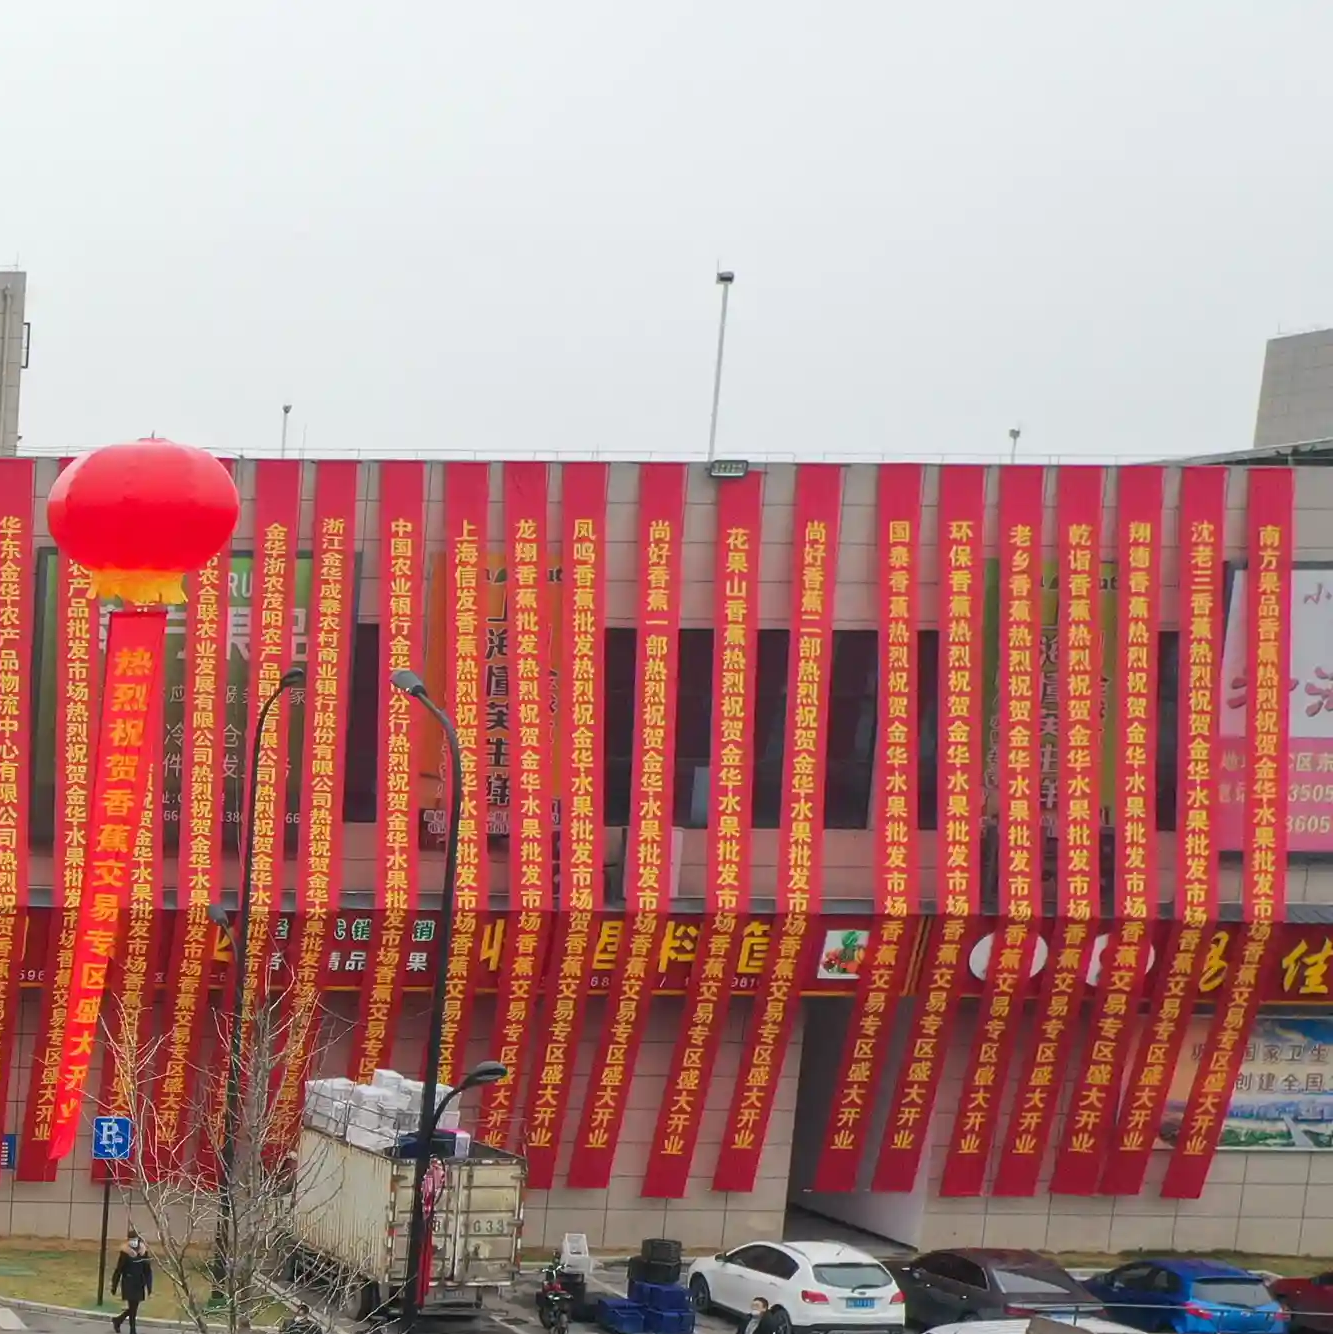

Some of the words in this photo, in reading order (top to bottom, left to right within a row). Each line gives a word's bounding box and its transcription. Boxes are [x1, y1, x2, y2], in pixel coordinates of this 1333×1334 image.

[356, 521, 413, 1086] 中国农业银行金华分行热烈祝贺金华水果批发市场香蕉交易专区
